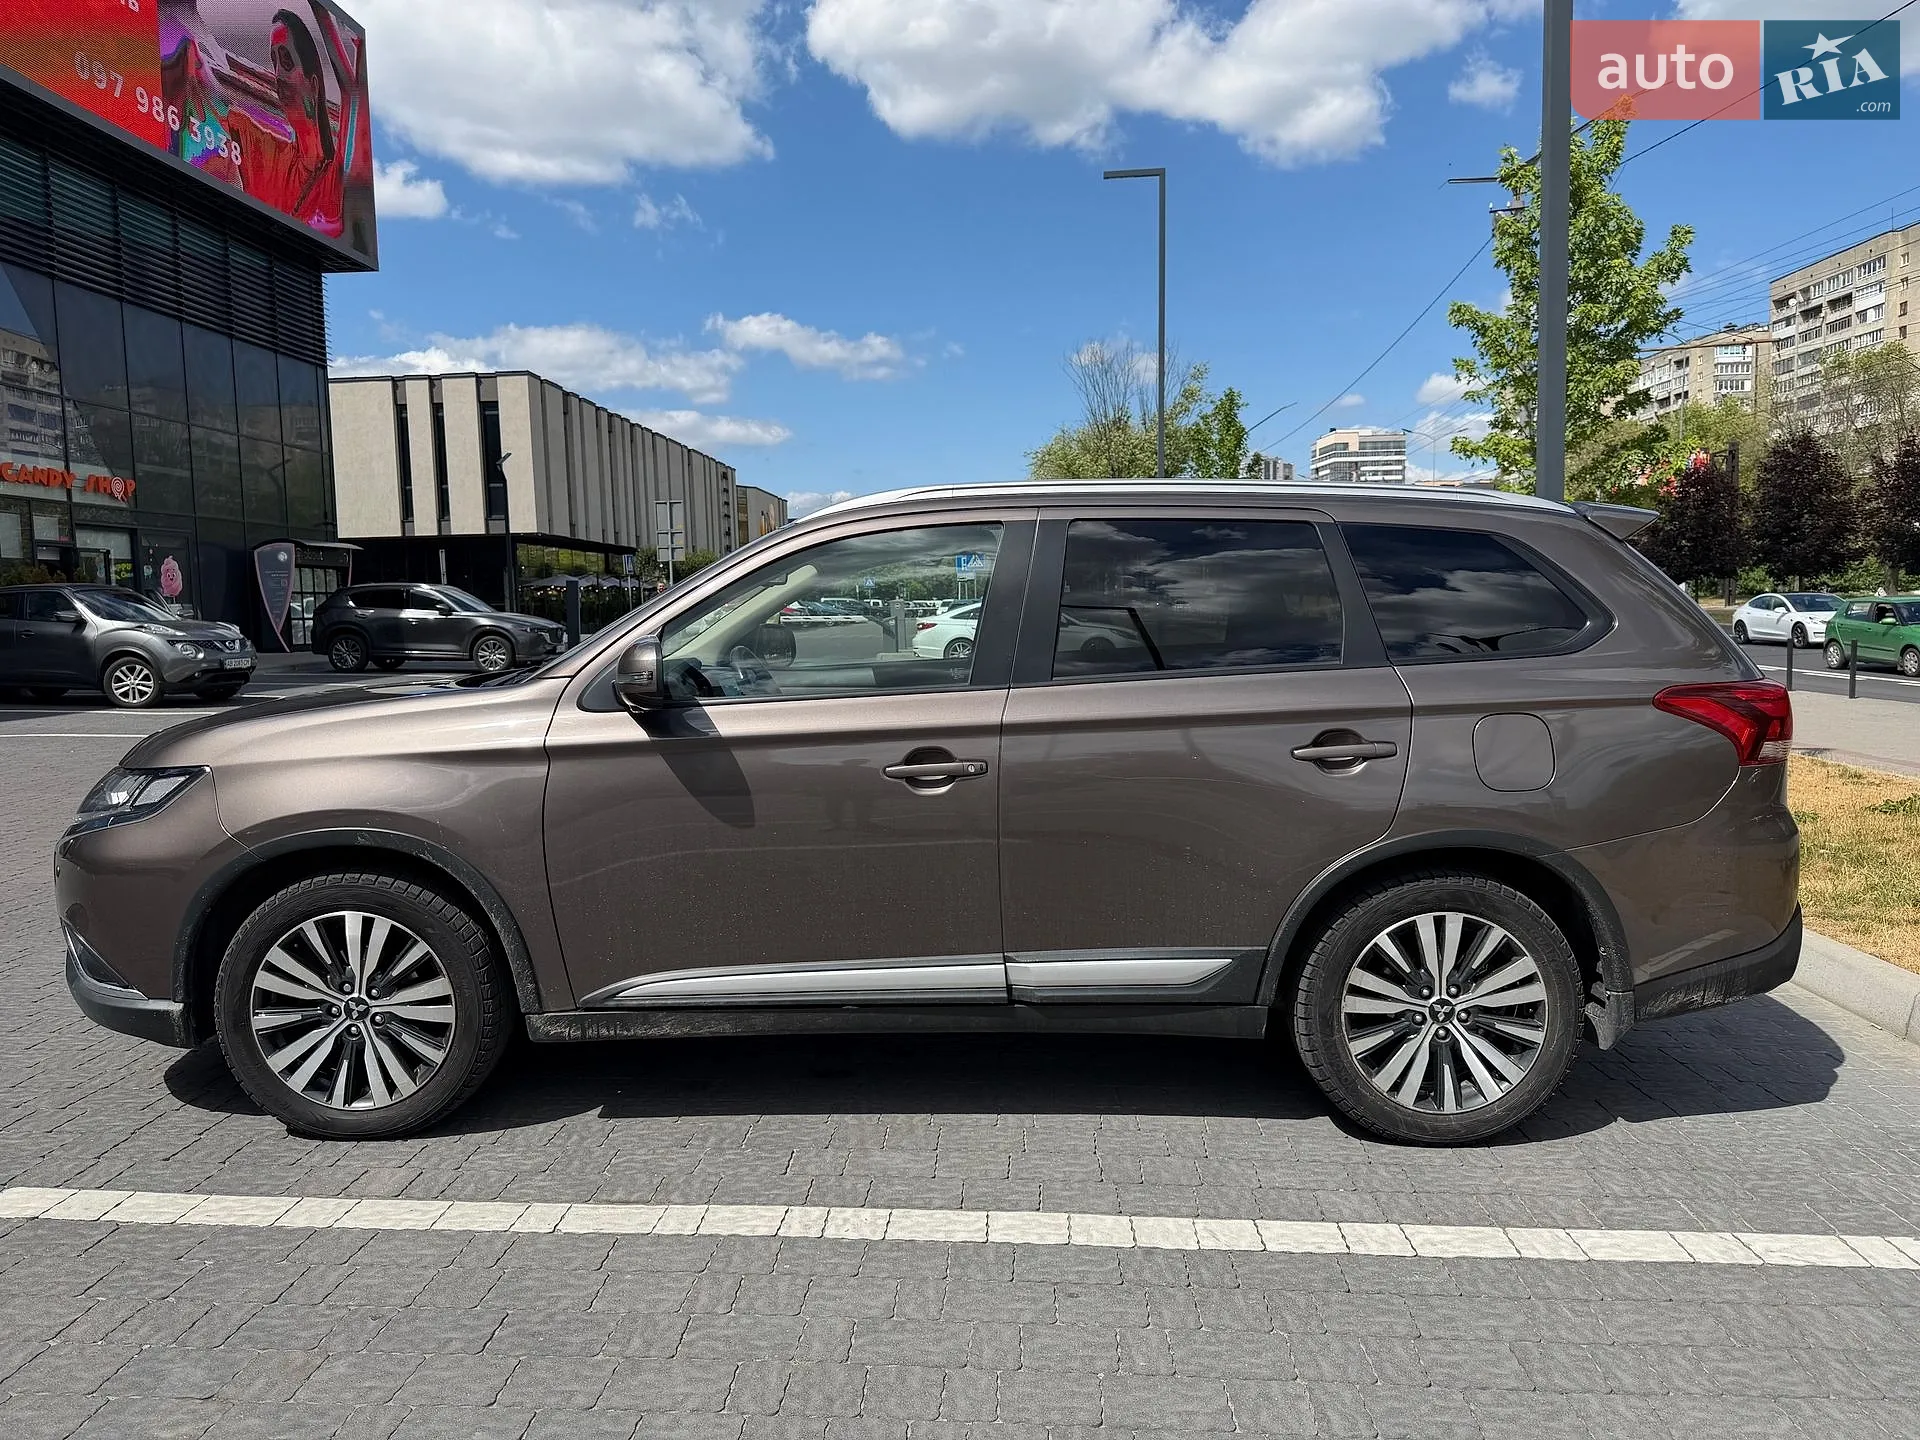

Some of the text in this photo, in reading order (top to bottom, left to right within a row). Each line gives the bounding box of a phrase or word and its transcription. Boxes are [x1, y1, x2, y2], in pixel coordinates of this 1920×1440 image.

[74, 51, 242, 165] 097 986 3938
[0, 461, 136, 501] CANDY SHOP
